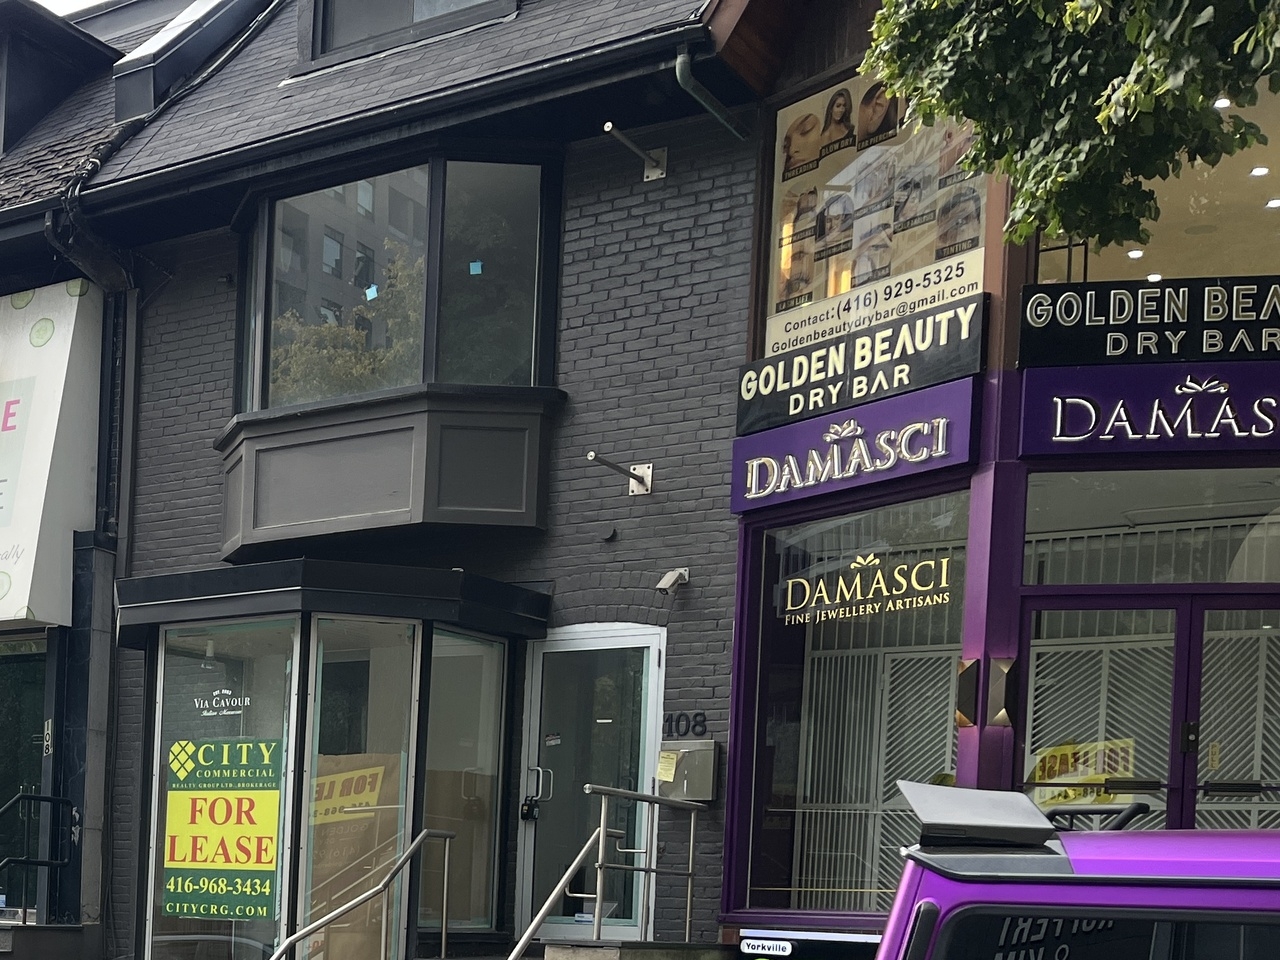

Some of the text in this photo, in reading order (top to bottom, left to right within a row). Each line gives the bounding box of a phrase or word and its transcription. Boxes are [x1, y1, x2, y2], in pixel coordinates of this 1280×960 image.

[822, 137, 854, 156] BLOW DRY
[783, 160, 818, 180] THREADING
[942, 240, 972, 256] TINTING
[883, 261, 966, 302] 929-5325
[772, 281, 979, 353] Goldenbeautydrybar@gmail.com
[1026, 287, 1189, 328] GOLDEN
[741, 303, 978, 400] GOLDEN BEAUTY
[1106, 330, 1186, 356] DRY
[789, 364, 911, 416] DRY BAR
[744, 417, 951, 499] DAMASCI
[785, 557, 951, 611] DAMASCI
[785, 591, 950, 626] FINE JEWELLERY ARTISANS
[663, 712, 708, 739] 108
[197, 742, 277, 766] CITY
[196, 768, 275, 778] COMMERCIAL
[187, 796, 257, 825] FOR
[166, 834, 274, 865] LEASE
[166, 876, 271, 896] 416-968-3434
[166, 902, 268, 917] CITYCRG.COM
[745, 941, 787, 953] Yorkville
